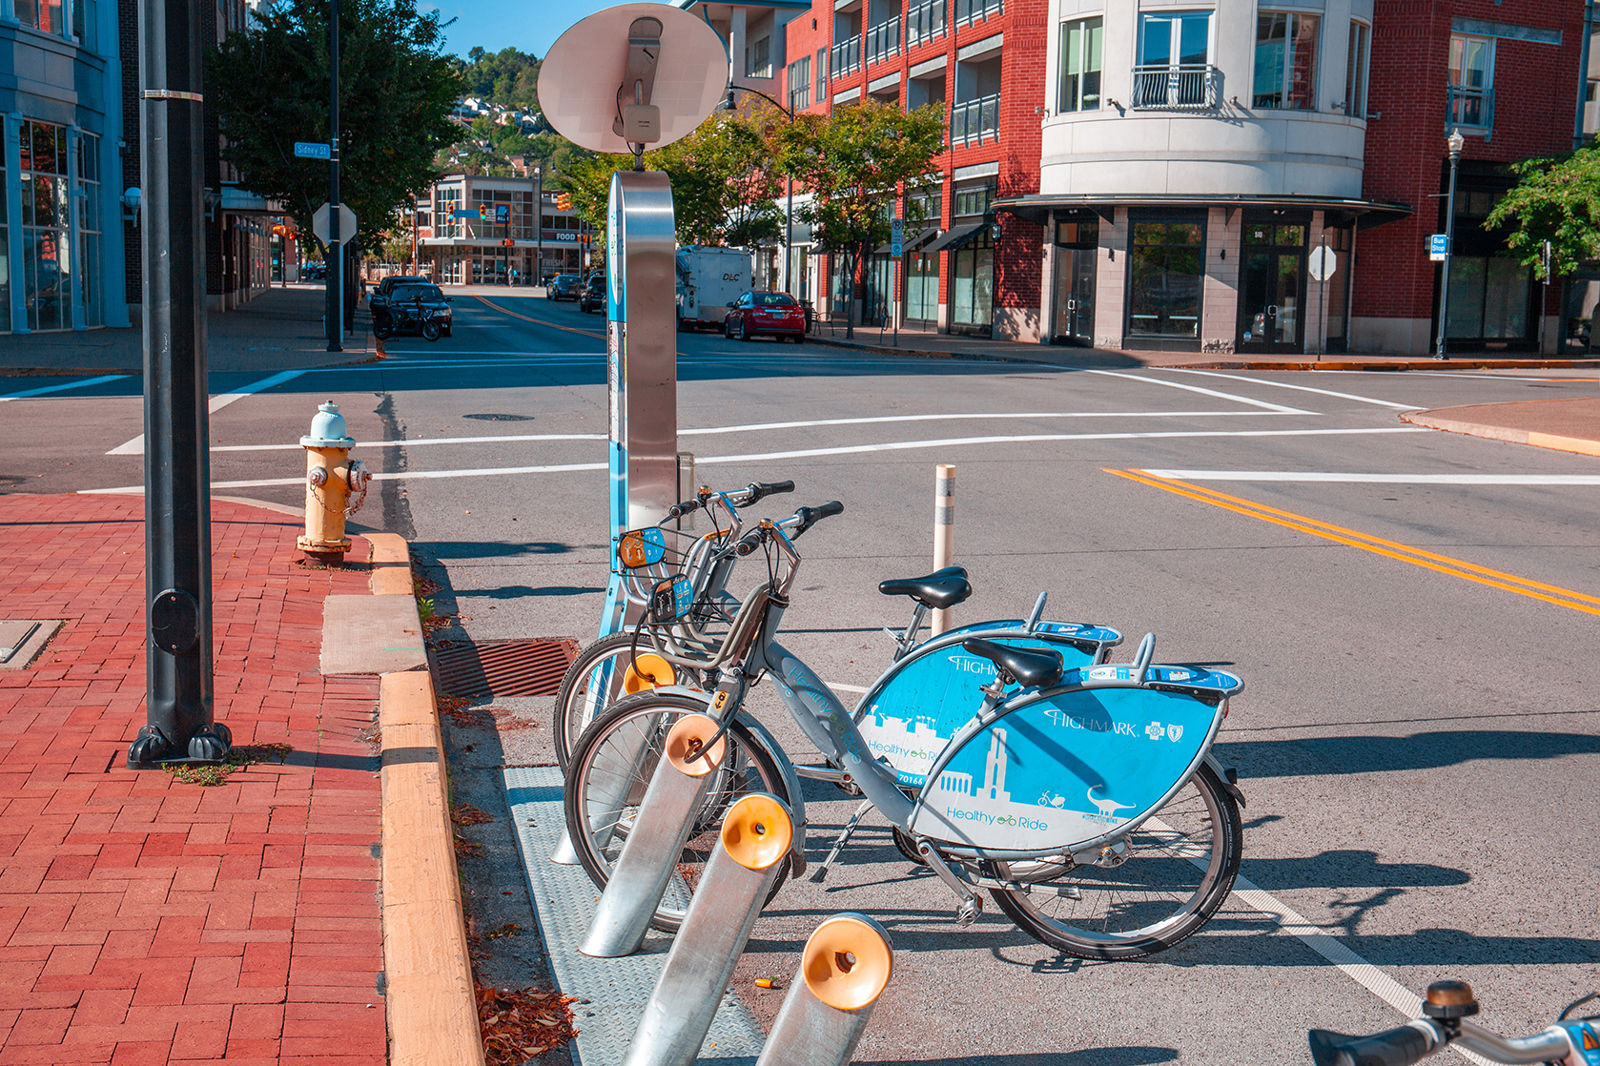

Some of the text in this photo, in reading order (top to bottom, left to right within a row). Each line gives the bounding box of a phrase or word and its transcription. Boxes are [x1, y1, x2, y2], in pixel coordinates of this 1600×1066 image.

[297, 144, 327, 156] Sidney St
[948, 655, 999, 675] HIGHM
[788, 666, 863, 764] Healthy Ride
[1043, 709, 1137, 738] HIGHMARK
[868, 739, 910, 758] Healthy
[898, 774, 923, 785] 70166
[946, 806, 1048, 831] Healthy Ride
